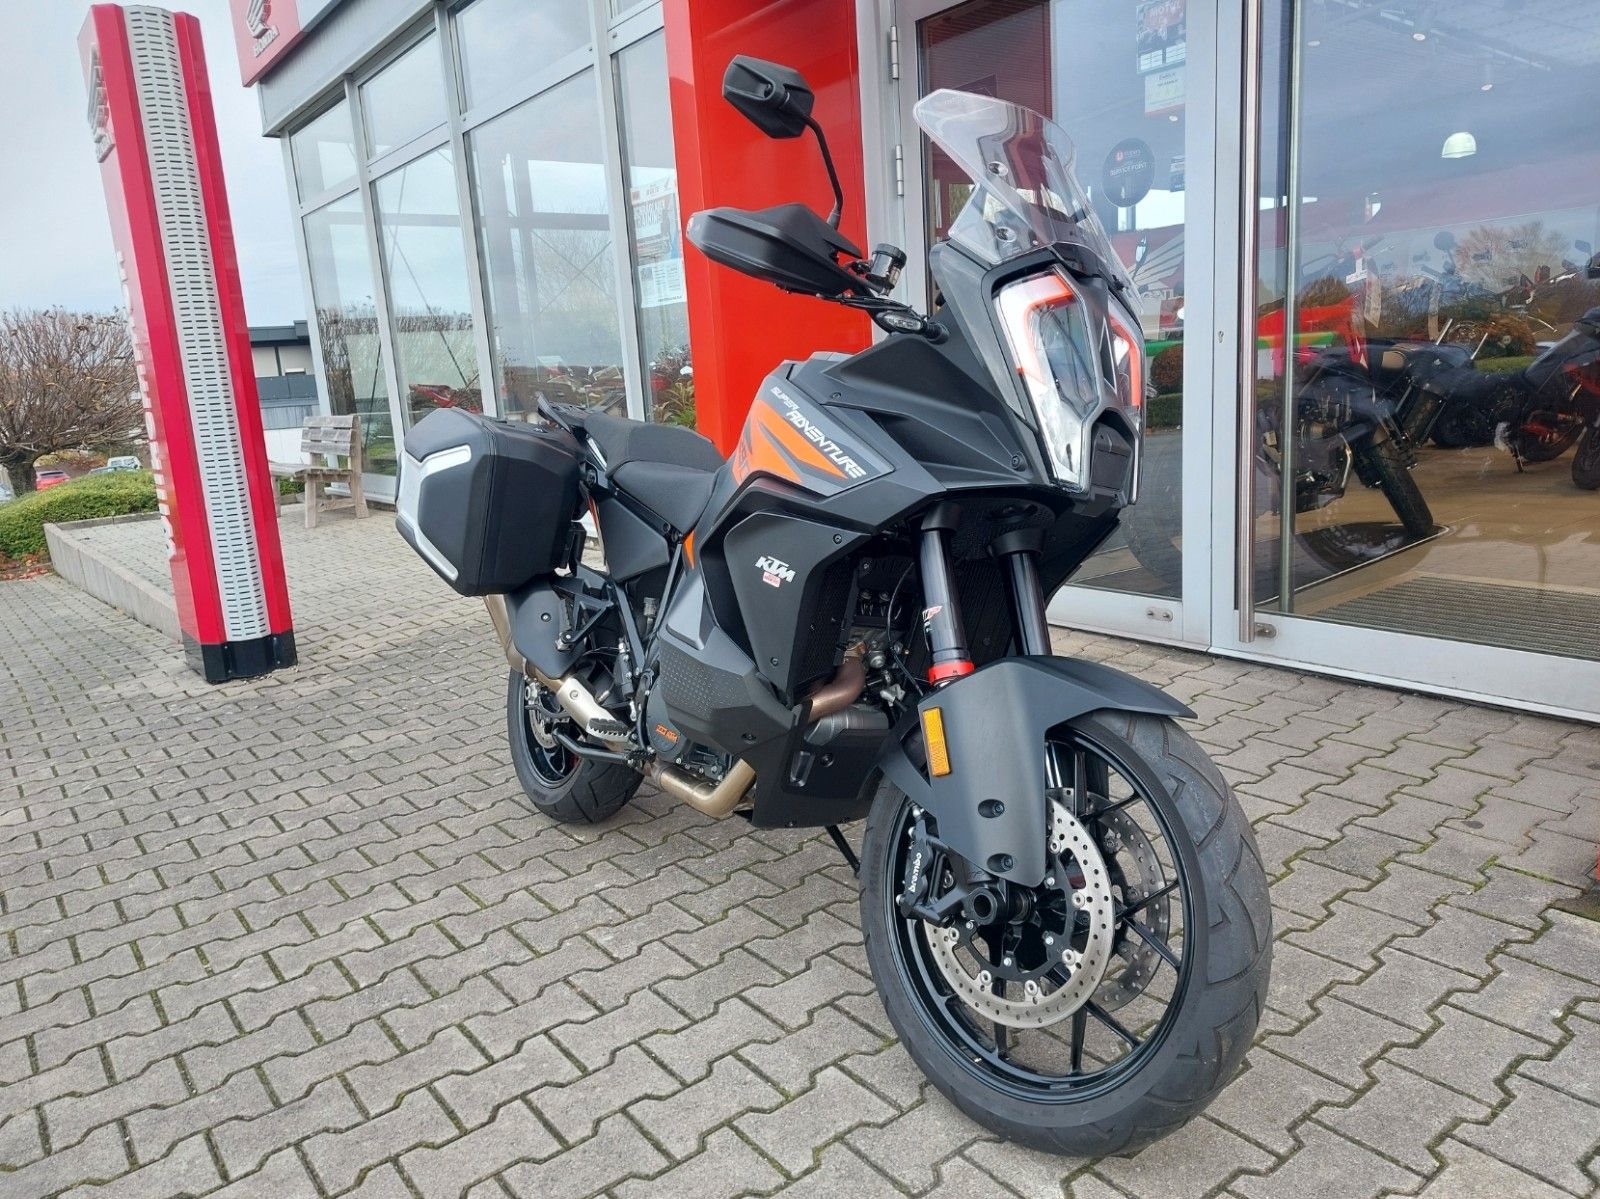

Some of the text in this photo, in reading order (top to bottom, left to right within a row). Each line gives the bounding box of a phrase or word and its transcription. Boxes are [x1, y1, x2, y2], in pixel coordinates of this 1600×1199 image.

[770, 386, 867, 479] SUPER ADVENTURE
[755, 555, 796, 583] KTM
[908, 852, 922, 893] brembo
